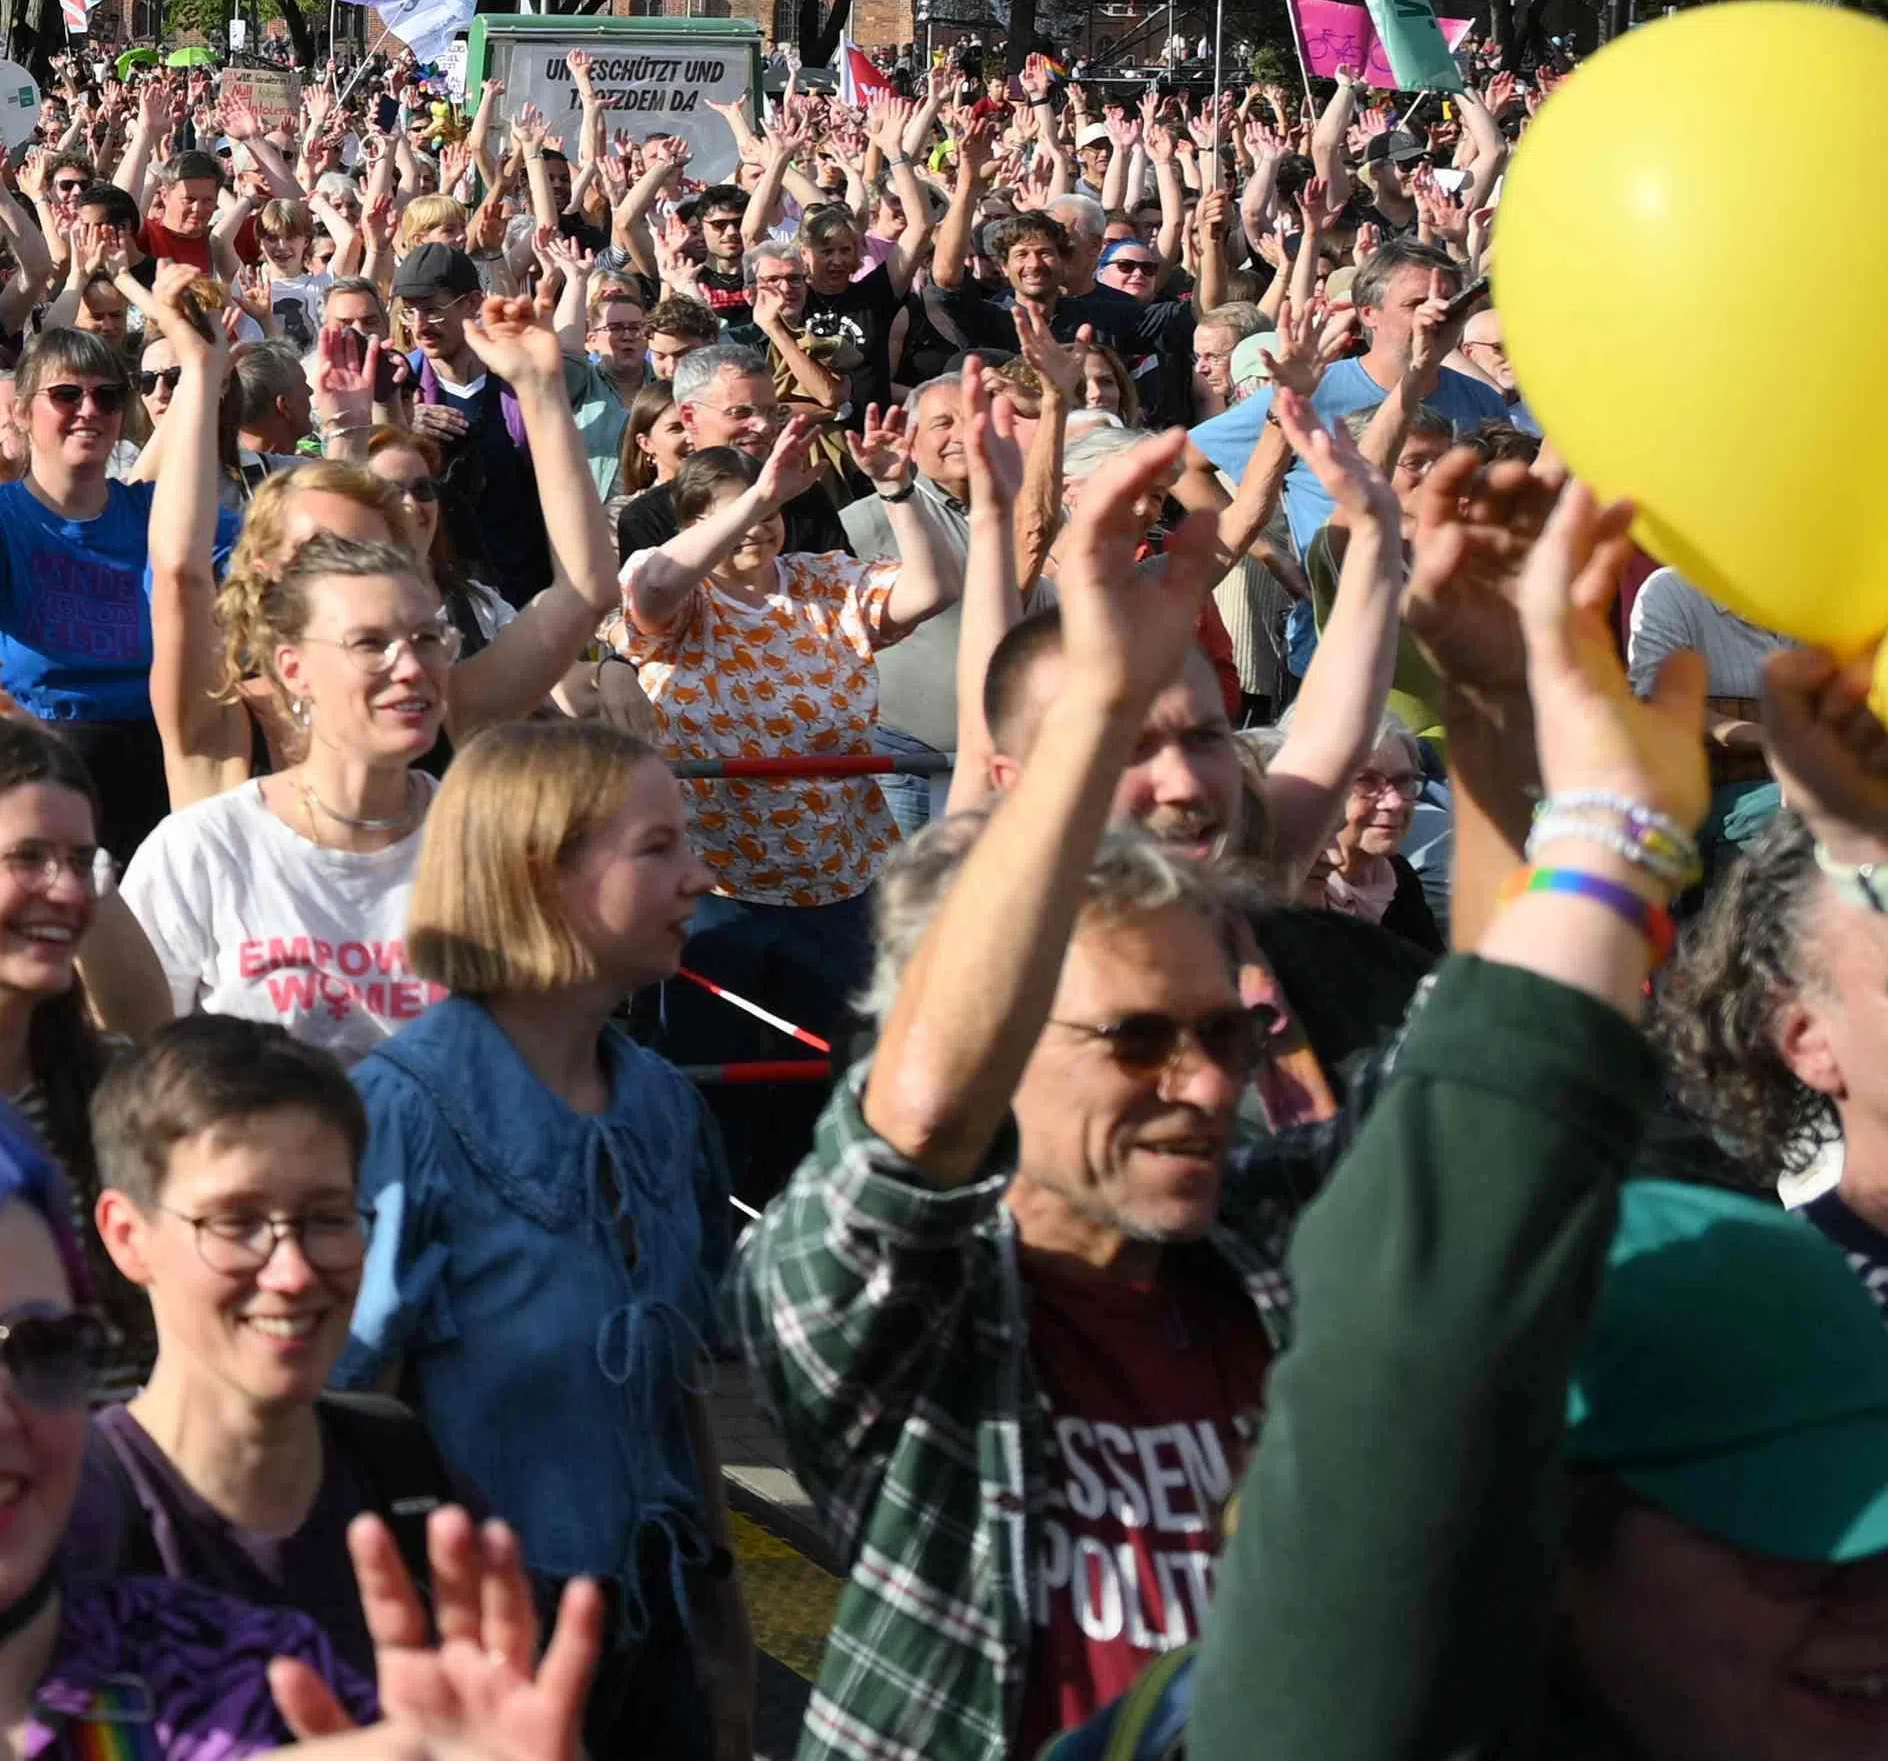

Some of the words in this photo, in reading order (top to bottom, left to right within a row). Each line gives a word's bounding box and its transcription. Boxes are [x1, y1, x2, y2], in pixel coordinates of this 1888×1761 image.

[545, 55, 683, 82] UNESCHÜTZT
[684, 60, 726, 84] UND
[567, 88, 666, 112] TOTZDEM
[669, 89, 699, 112] DA
